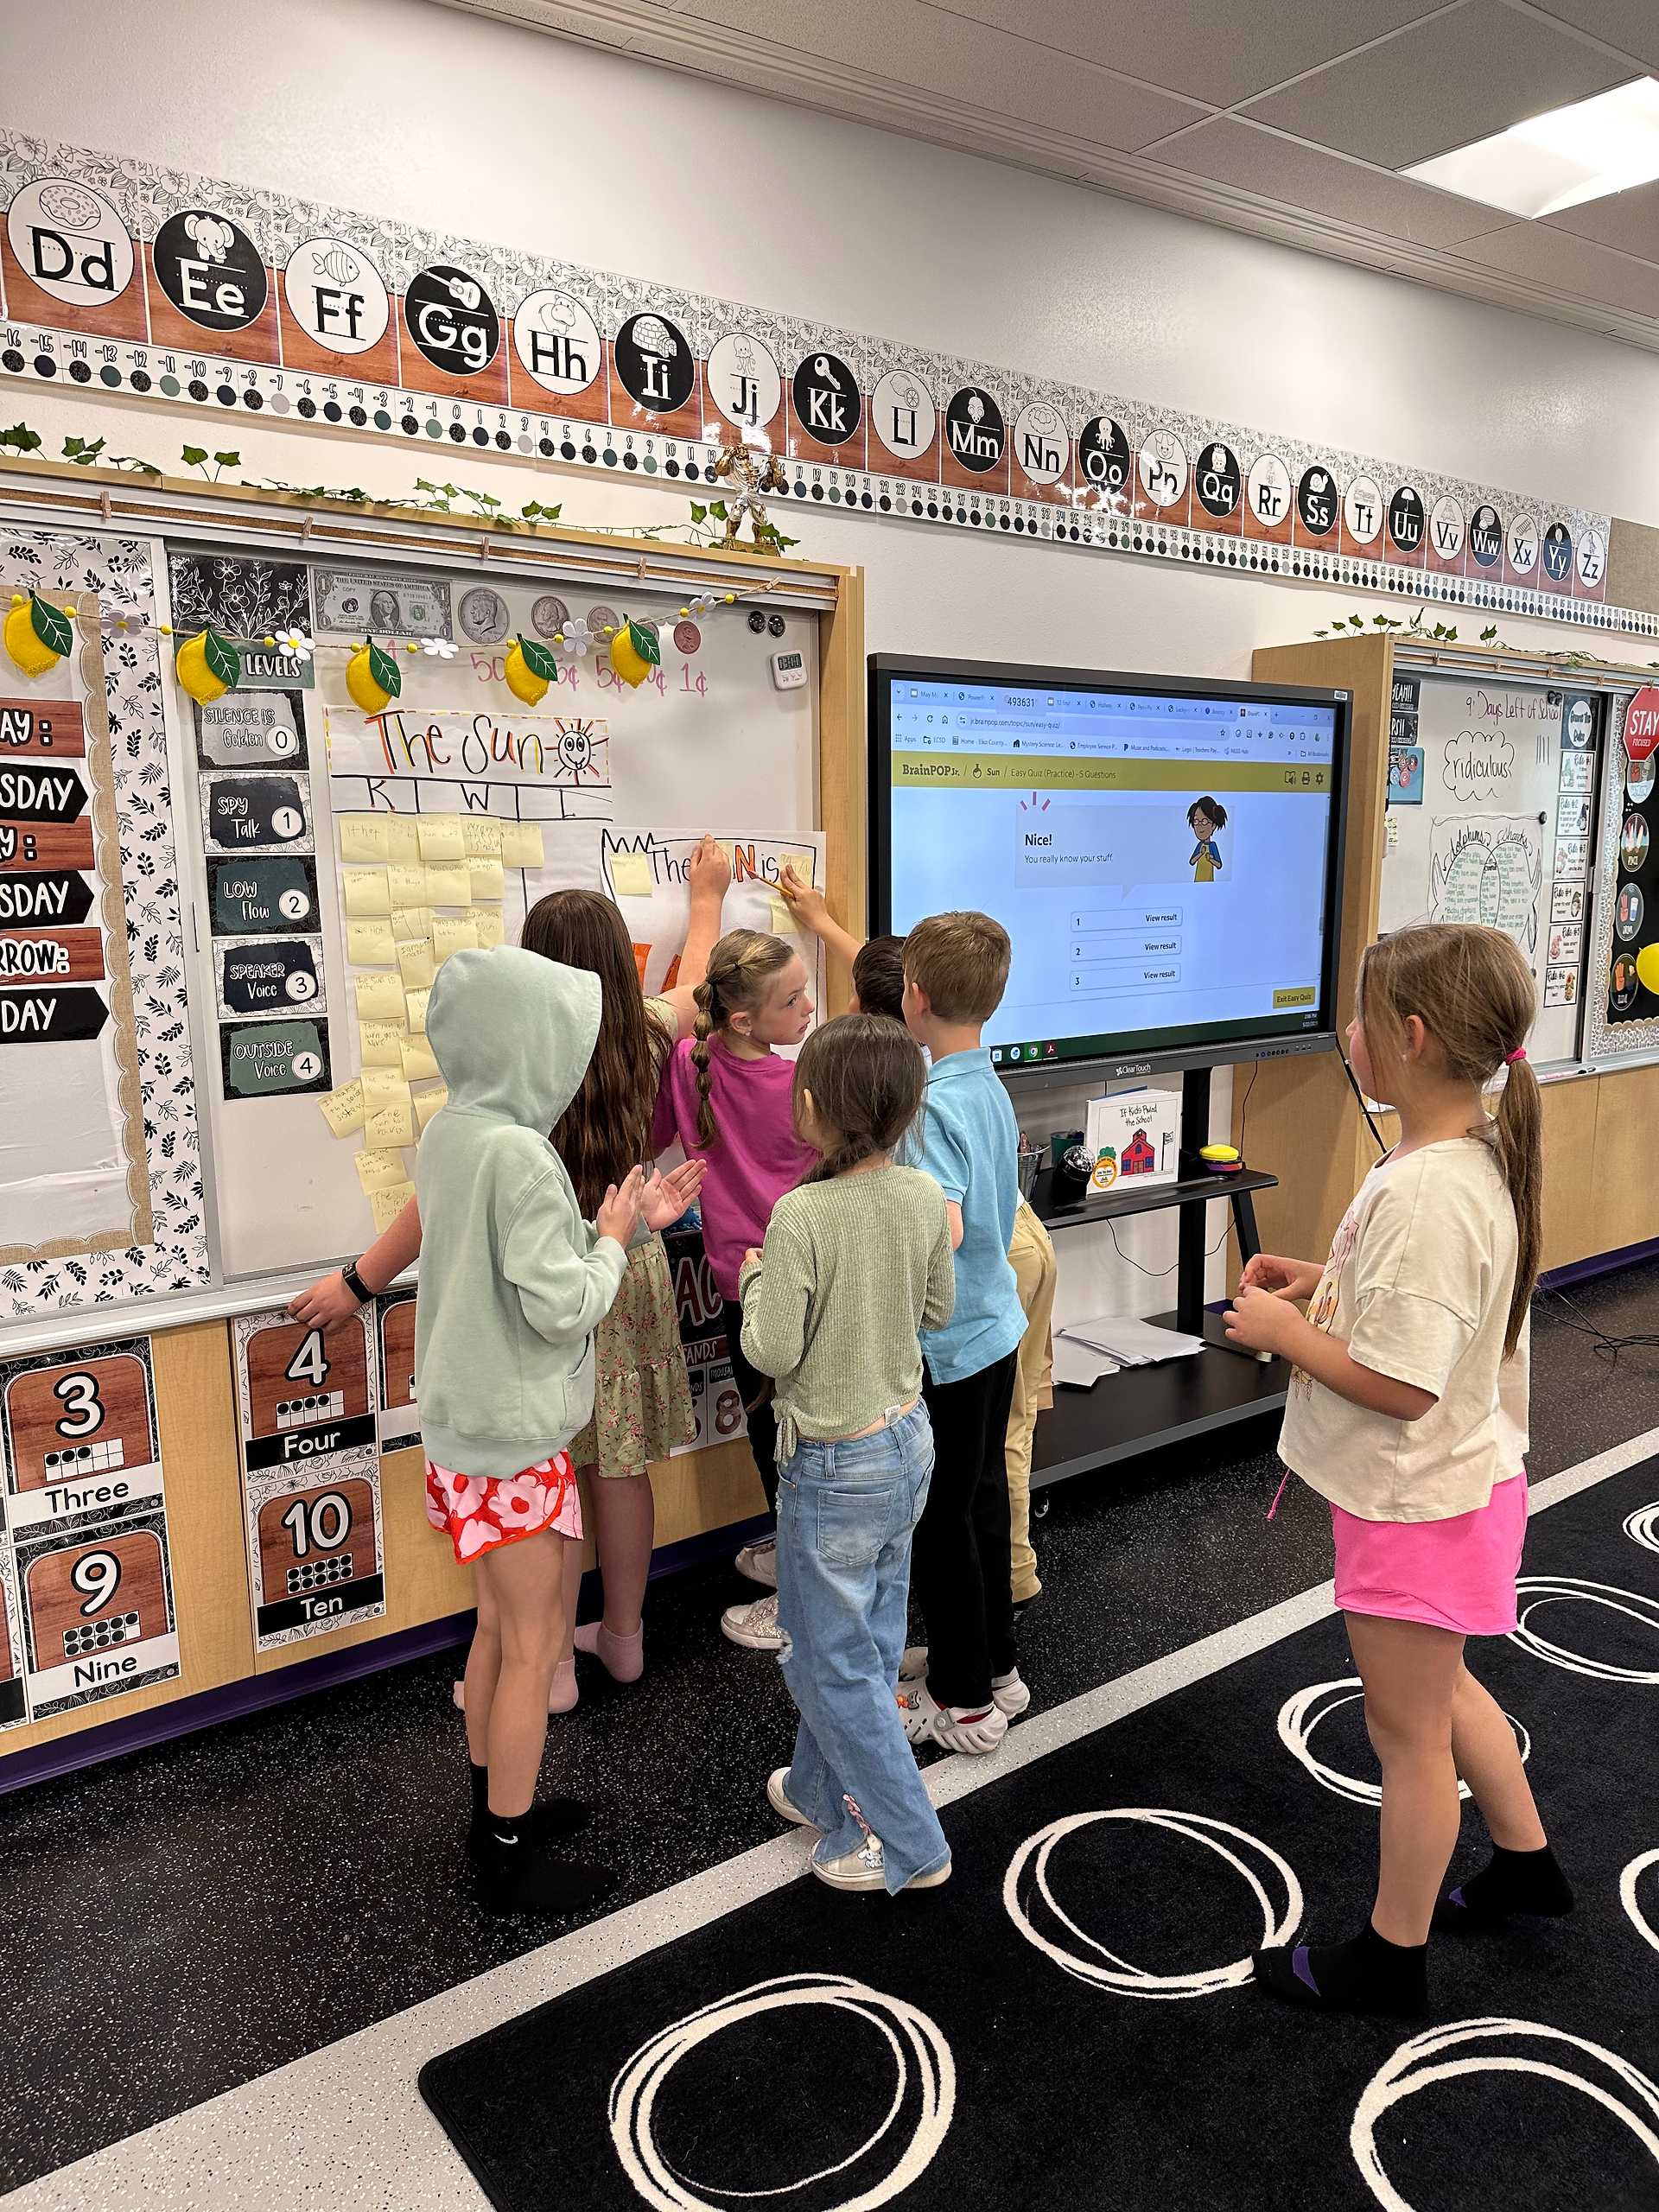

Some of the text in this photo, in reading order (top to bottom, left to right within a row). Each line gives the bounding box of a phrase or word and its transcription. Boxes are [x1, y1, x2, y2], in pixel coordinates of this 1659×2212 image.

[32, 228, 114, 290] Dd
[181, 259, 245, 315] Ee
[316, 288, 364, 339] Ff
[419, 304, 490, 368] Gg
[531, 331, 586, 382] Hh
[641, 355, 670, 399] Ii
[63, 340, 677, 456] -14 -13 -12 -10 -9 -8 -5 -4 -3 10
[732, 377, 758, 426] Jj
[810, 388, 846, 431] Kk
[893, 407, 916, 446] Ll
[952, 422, 999, 458] Mm
[1024, 434, 1060, 473] Nn
[1086, 452, 1122, 484] Oo
[1202, 474, 1234, 511] Qq
[1259, 485, 1280, 516] Rr
[1306, 496, 1328, 525] Ss
[1355, 504, 1373, 533] Tt
[1394, 513, 1418, 542] Uu
[1436, 523, 1459, 550] Vv
[1472, 531, 1499, 556] Ww
[1514, 539, 1530, 565] Xx
[1549, 546, 1567, 580] Yy
[1582, 555, 1599, 578] Zz
[349, 578, 369, 587] UNITED
[370, 580, 393, 588] STATES
[245, 652, 302, 677] LEVELS
[778, 657, 802, 671] 03:00
[680, 663, 708, 696] 1¢
[1007, 696, 1034, 707] 493631
[1478, 690, 1503, 726] Days
[1506, 694, 1525, 719] Left
[1527, 700, 1535, 719] of
[1539, 698, 1561, 721] School
[204, 708, 276, 725] SILENCE IS
[1630, 710, 1659, 735] STAY
[223, 728, 263, 748] Golden
[275, 731, 288, 748] 0
[364, 709, 544, 775] The Sun
[1632, 739, 1651, 747] FOCUSED
[1011, 768, 1027, 779] Easy
[1027, 769, 1043, 778] Quiz
[1044, 769, 1075, 779] (Practice)
[1084, 771, 1116, 779] Questions
[1453, 752, 1509, 780] ridiculous
[218, 797, 248, 815] SPY
[365, 779, 396, 811] K
[461, 783, 489, 812] W
[559, 788, 575, 819] L
[231, 819, 260, 839] Talk
[283, 812, 290, 830] 1
[1025, 834, 1052, 846] Nice!
[761, 854, 779, 883] is
[1025, 854, 1114, 864] You really know your stuff.
[223, 881, 257, 899] LOW
[289, 897, 301, 912] 2
[241, 901, 270, 921] Flow
[229, 963, 285, 979] SPEAKER
[296, 977, 308, 994] 3
[247, 982, 277, 1000] Voice
[233, 1040, 295, 1060] OUTSIDE
[254, 1061, 287, 1079] Voice
[300, 1058, 313, 1073] 4
[1125, 1116, 1153, 1127] the School
[1128, 1106, 1142, 1117] Kids
[1143, 1104, 1158, 1115] Ruled
[285, 1328, 331, 1388] 4
[54, 1371, 105, 1440] 3
[715, 1389, 741, 1434] 8
[284, 1429, 340, 1459] Four
[45, 1481, 129, 1514] Three
[282, 1491, 353, 1559] 10
[71, 1549, 122, 1617] 9
[301, 1596, 343, 1621] Ten
[74, 1654, 137, 1688] Nine
